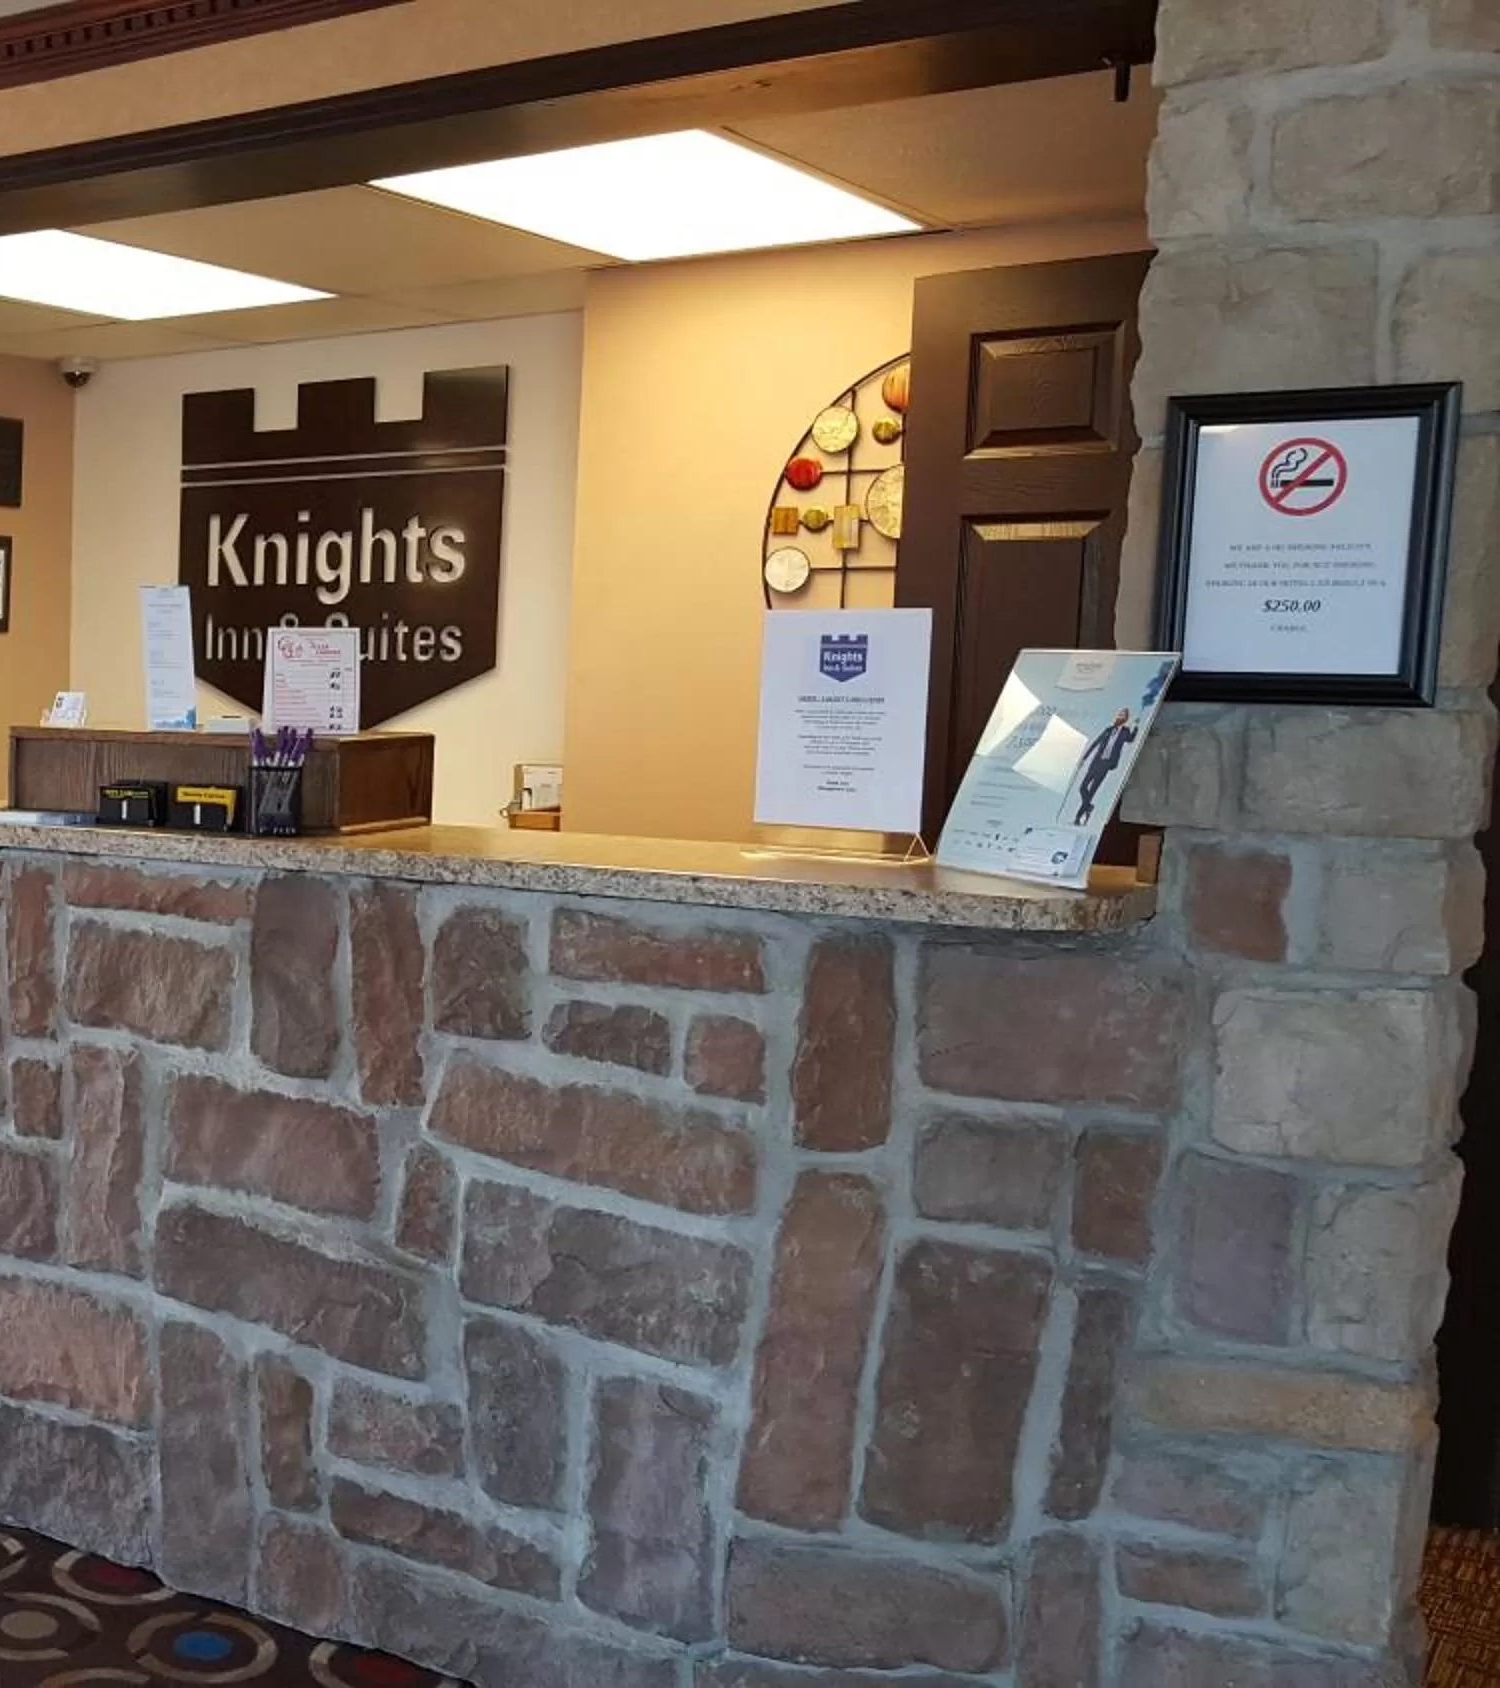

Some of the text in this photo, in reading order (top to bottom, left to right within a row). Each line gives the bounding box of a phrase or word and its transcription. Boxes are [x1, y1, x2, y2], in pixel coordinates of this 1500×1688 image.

[206, 507, 466, 605] Knights
[1262, 599, 1322, 613] $250.00
[205, 612, 264, 661] Inn
[823, 651, 863, 664] Knights
